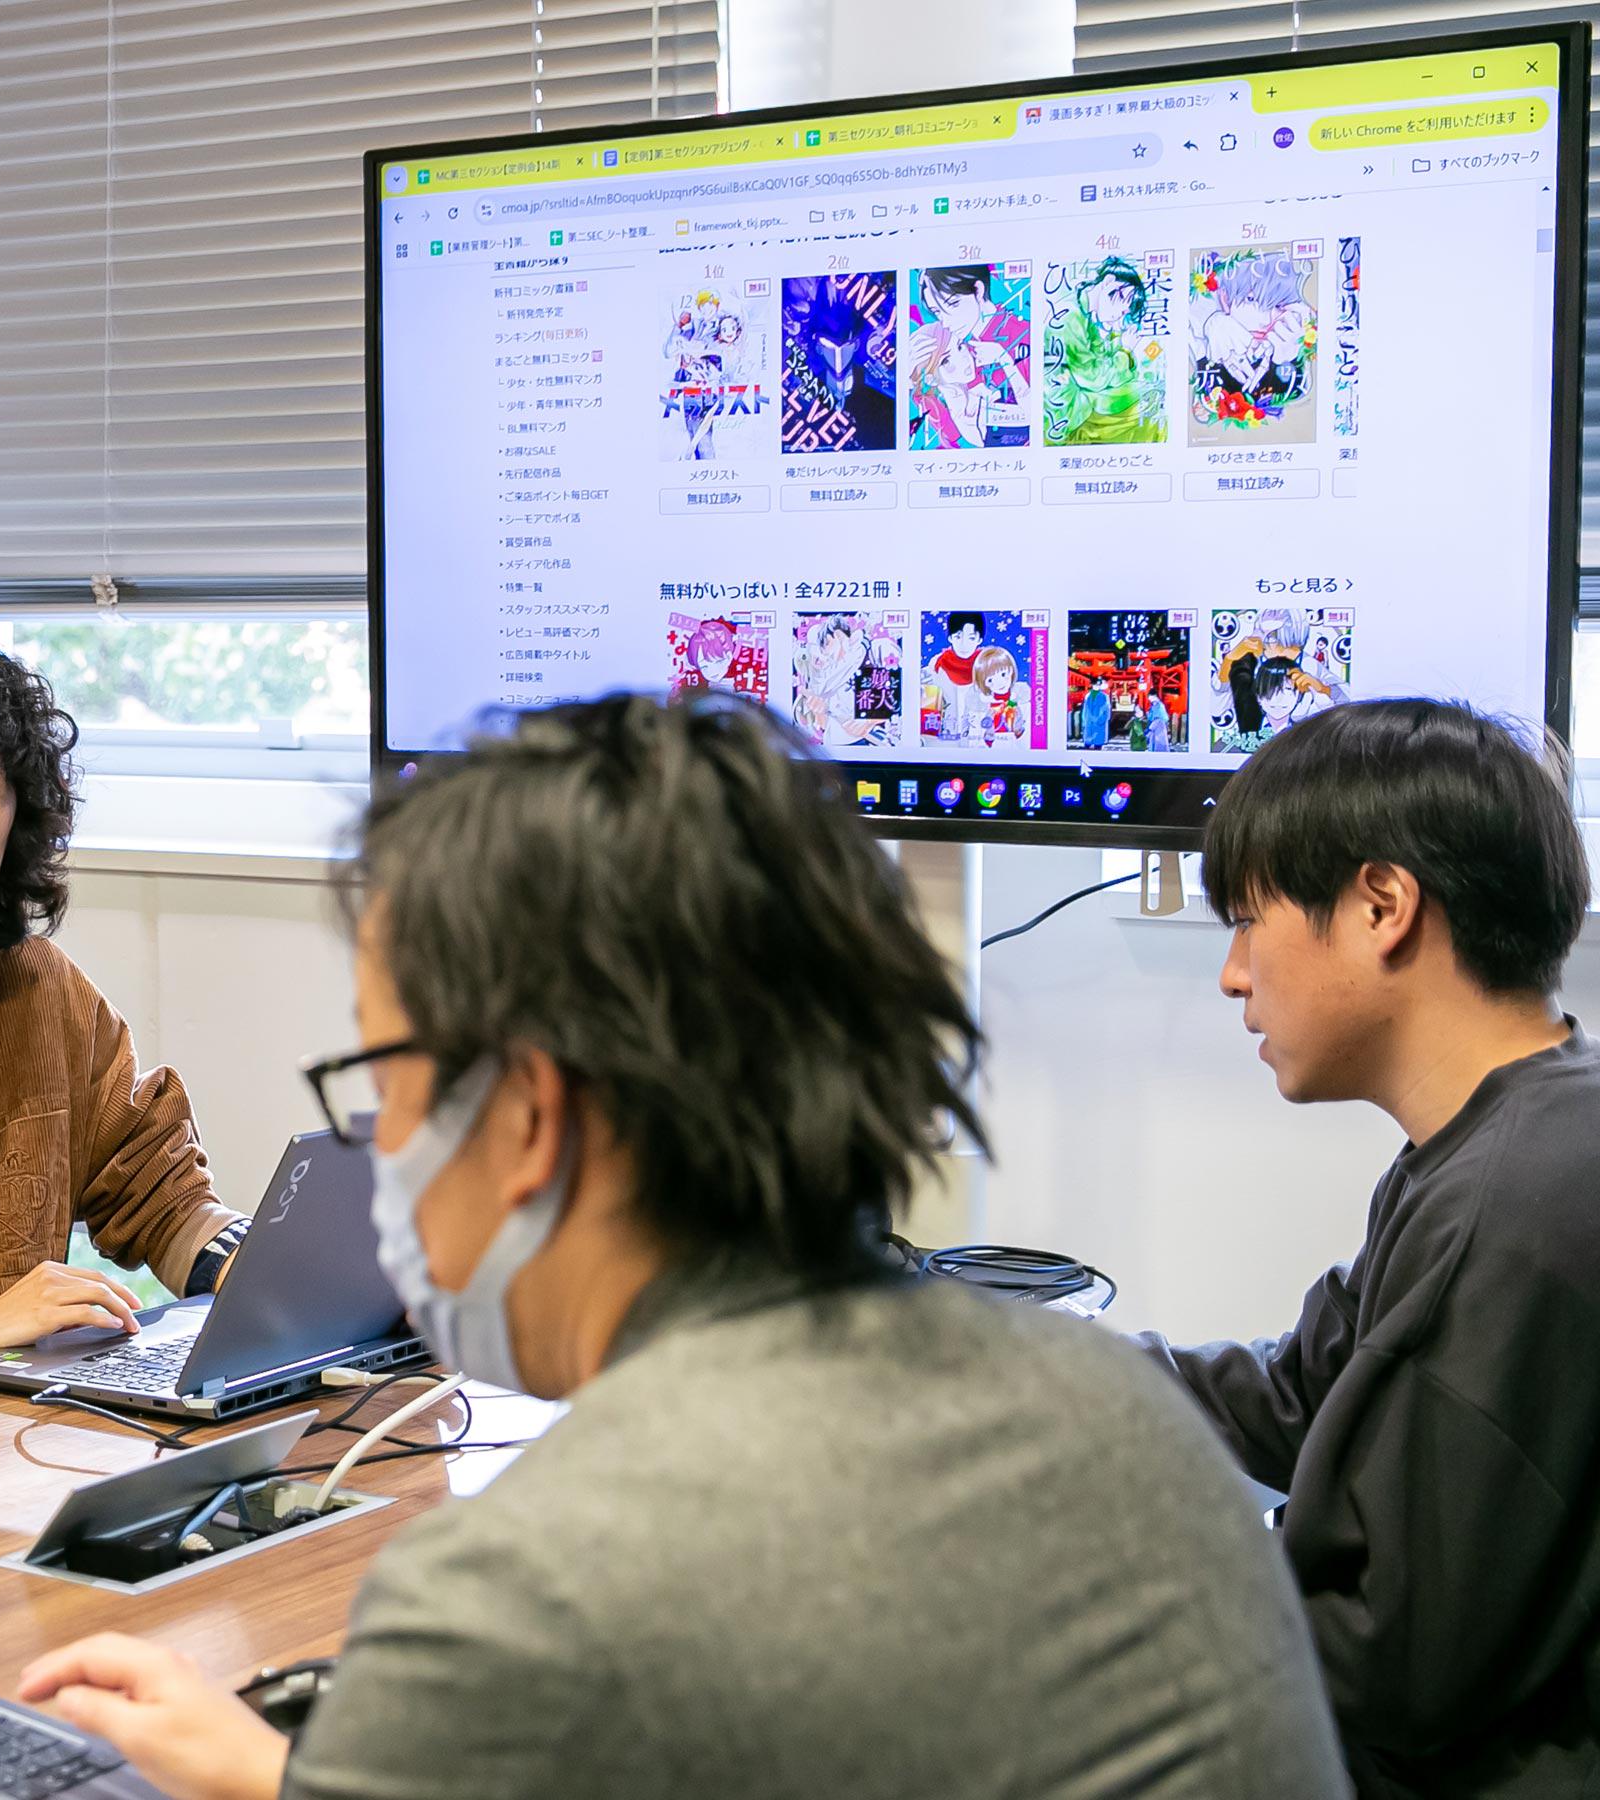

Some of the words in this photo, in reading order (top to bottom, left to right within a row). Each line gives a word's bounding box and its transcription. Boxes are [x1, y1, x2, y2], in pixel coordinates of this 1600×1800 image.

[1320, 127, 1353, 140] 新しい
[1357, 123, 1402, 137] Chrome
[1407, 111, 1518, 132] をご利用いただけます
[1440, 151, 1540, 171] すべてのブックマーク
[1102, 181, 1178, 199] 社外スキル研究
[831, 208, 857, 222] モデル
[893, 203, 919, 216] ツール
[1241, 223, 1267, 239] 5位
[1095, 234, 1120, 250] 4位
[958, 245, 982, 260] 3位
[827, 255, 850, 270] 2位
[704, 264, 725, 279] 1位
[494, 283, 574, 298] 新刊コミック/書籍
[495, 352, 590, 367] まるごと無料コミック
[1059, 455, 1154, 470] 薬屋のひとりごと
[1207, 451, 1294, 465] ゆびさきと恋々
[785, 464, 893, 479] 俺だけレベルアップな
[914, 460, 1027, 474] マイ・ワンナイト・ル
[689, 469, 740, 481] メダリスト
[938, 484, 999, 498] 無料立読み
[1074, 481, 1139, 494] 無料立読み
[1217, 478, 1285, 491] 無料立読み
[687, 492, 742, 505] 無料立読み
[810, 489, 868, 502] 無料立読み
[659, 580, 903, 600] 無料がいっぱい！全47221冊！
[1255, 577, 1338, 594] もっと見る
[505, 604, 610, 616] スタッフオススメマンガ
[1035, 634, 1045, 686] MARGARET
[685, 673, 699, 687] 13
[1035, 687, 1045, 727] COMICS
[1065, 789, 1080, 802] Ps
